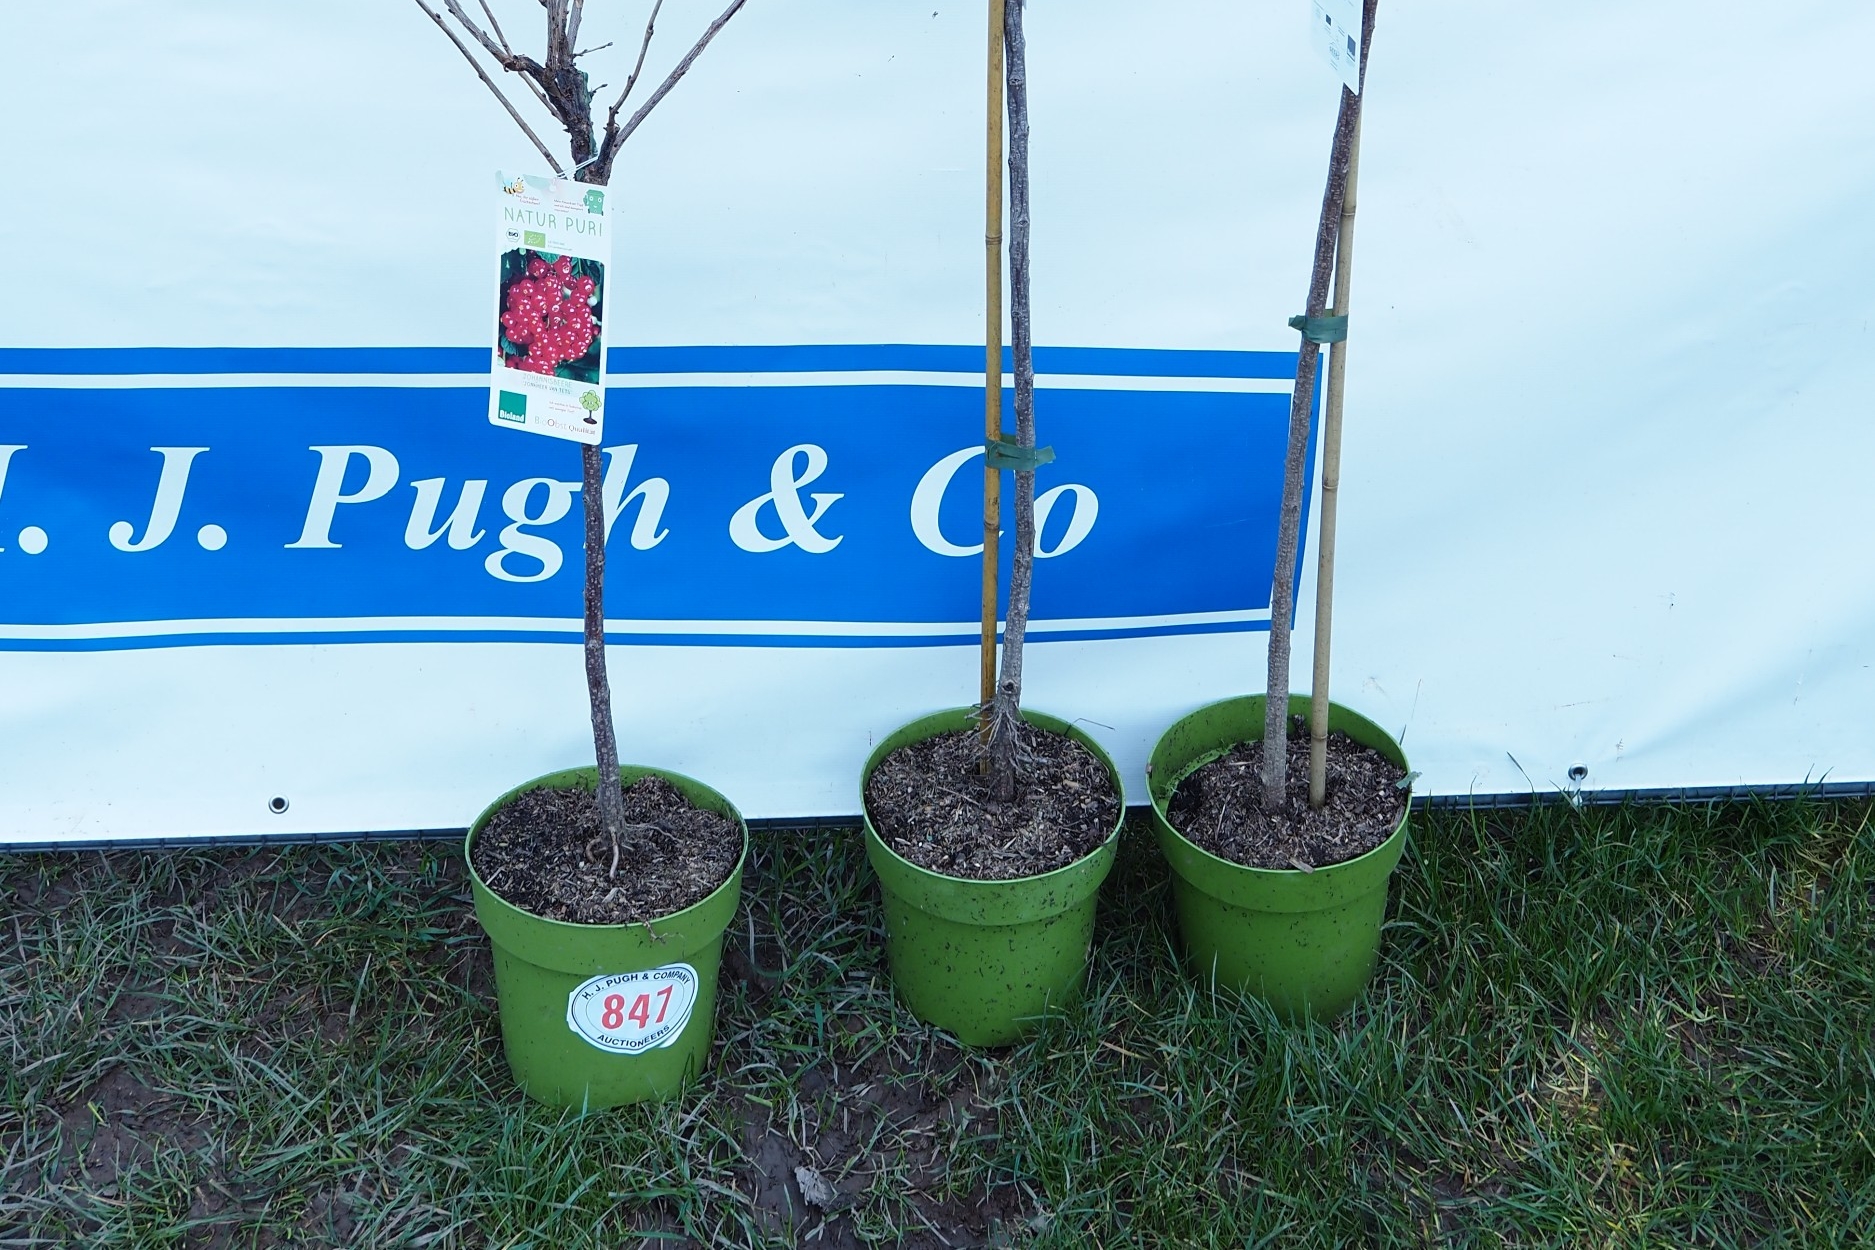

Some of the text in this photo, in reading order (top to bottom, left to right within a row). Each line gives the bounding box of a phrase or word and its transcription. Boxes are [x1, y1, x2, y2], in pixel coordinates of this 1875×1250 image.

[504, 206, 557, 229] NATUR
[499, 410, 525, 423] Bioland
[108, 447, 228, 552] J.
[285, 445, 670, 583] Pugh
[730, 444, 845, 554] &
[910, 445, 1100, 559] Co
[581, 992, 594, 1001] H.
[606, 974, 638, 988] PUGH
[642, 972, 649, 981] &
[653, 970, 691, 985] COMPANY
[601, 984, 673, 1029] 847
[597, 1025, 670, 1047] AUCTIONEERS
